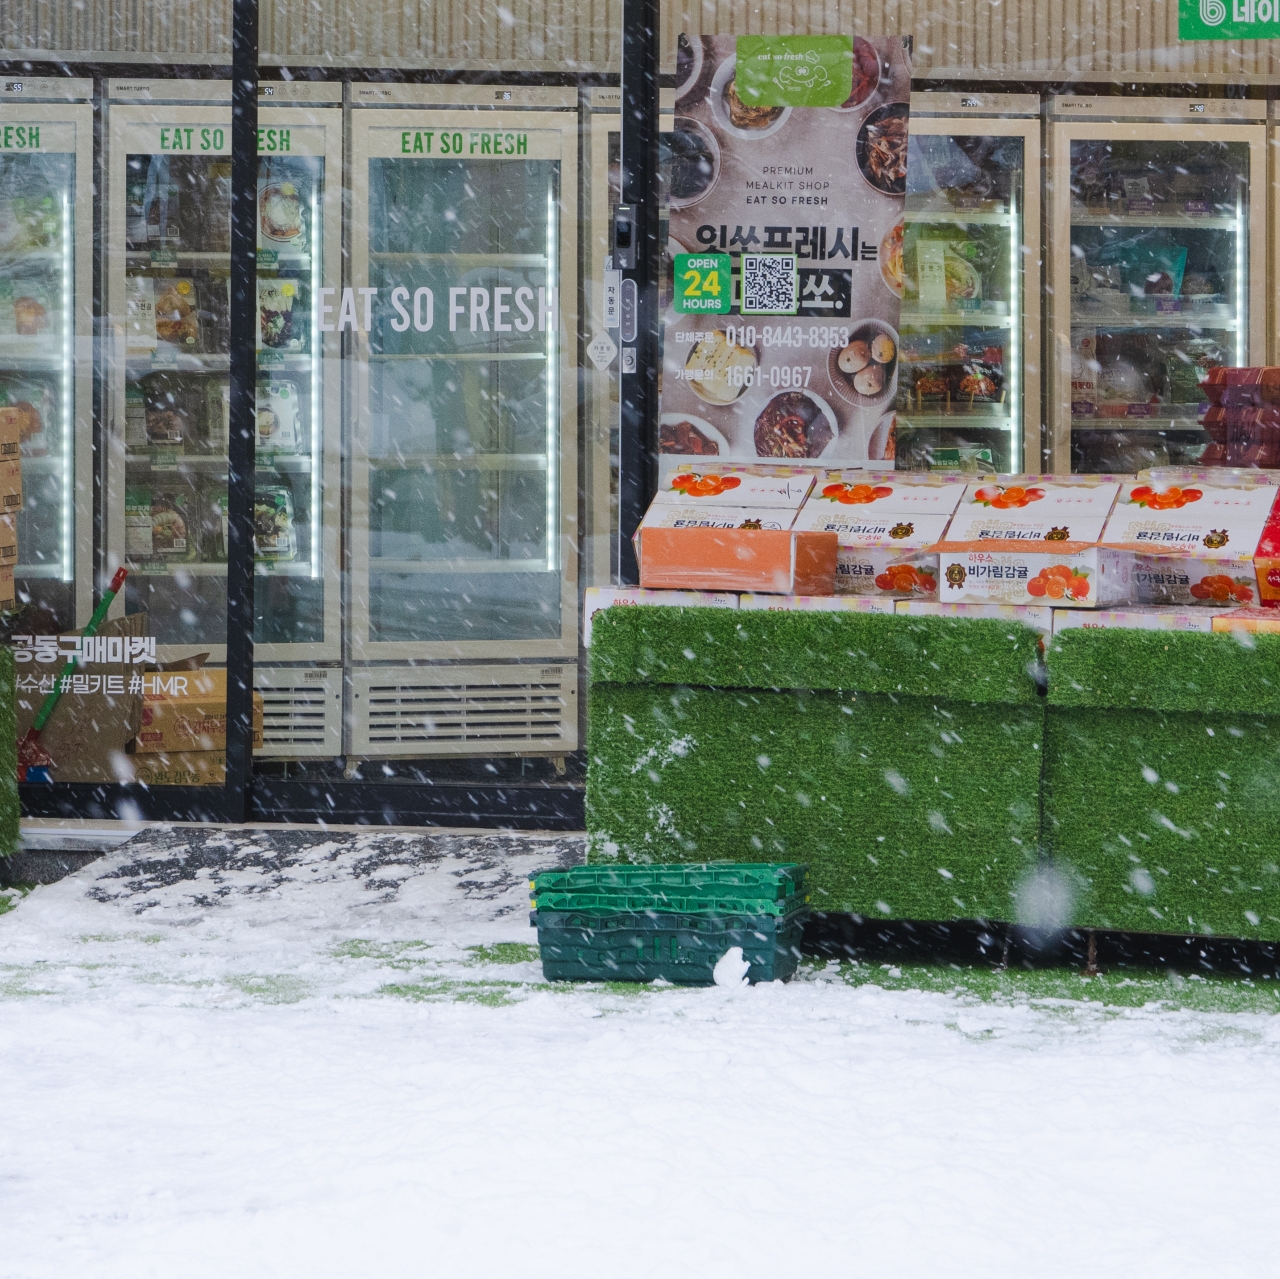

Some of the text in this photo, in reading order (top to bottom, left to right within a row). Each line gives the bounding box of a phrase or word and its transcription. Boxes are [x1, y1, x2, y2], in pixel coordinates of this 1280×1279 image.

[783, 52, 804, 61] fresh
[160, 128, 224, 151] EAT SO
[401, 131, 528, 155] EAT SO FRESH
[762, 166, 813, 175] PREMIUM
[746, 181, 830, 190] MEALKIT SHOP
[746, 195, 828, 205] EAT SO FRESH
[687, 258, 718, 269] OPEN
[683, 270, 721, 297] 24
[319, 286, 558, 332] EAT SO FRESH
[682, 298, 722, 309] HOURS
[675, 325, 849, 349] 단체주문 010-8443-8353
[675, 366, 812, 388] 가맹문의 1661-0967
[968, 553, 993, 563] 하우스
[968, 565, 1028, 580] 비가림감귤
[11, 634, 156, 664] 공동구매마켓
[60, 673, 125, 695] #밀키트
[129, 674, 188, 696] #HMR
[154, 771, 200, 784] 완도김우동
